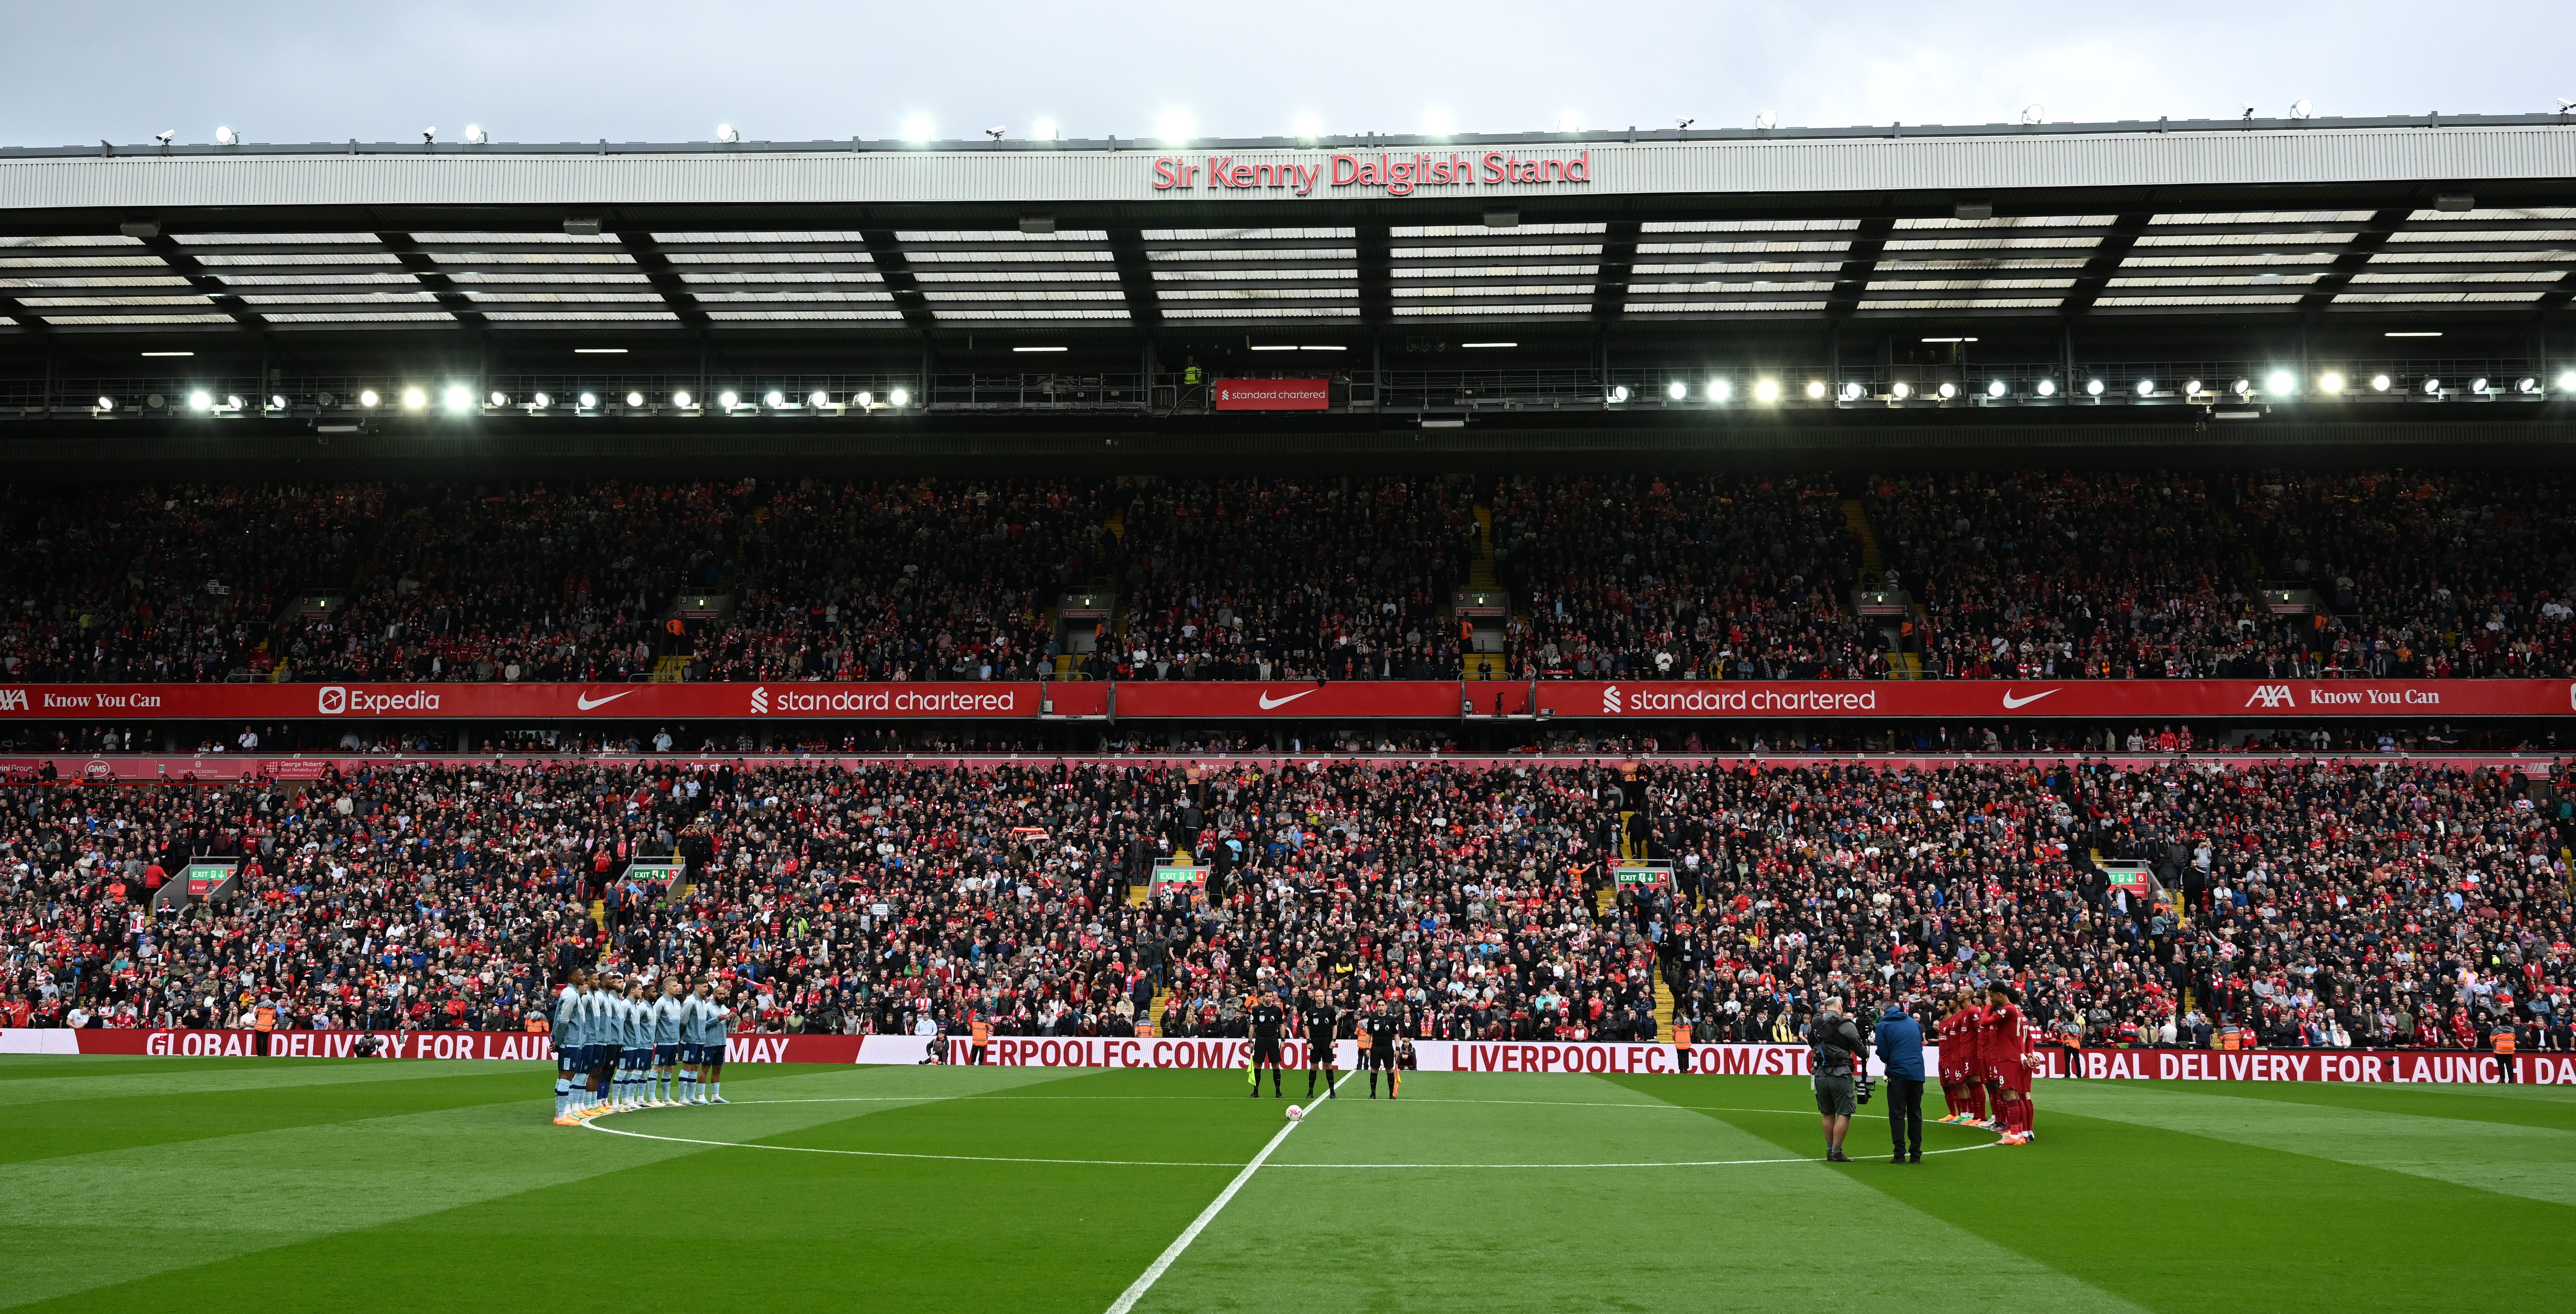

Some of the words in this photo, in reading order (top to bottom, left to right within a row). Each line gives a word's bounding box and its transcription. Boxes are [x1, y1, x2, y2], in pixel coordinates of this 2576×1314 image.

[1155, 158, 1197, 187] Sir
[1210, 158, 1319, 193] Kenny
[1333, 154, 1473, 193] Dalglish
[1484, 151, 1588, 182] Stand
[44, 694, 91, 707] Know
[96, 694, 125, 706] You
[131, 694, 160, 706] Can
[351, 690, 439, 714] Expedia
[778, 691, 888, 710] standard
[896, 691, 1013, 710] chartered
[1631, 690, 1745, 710] standard
[1752, 690, 1875, 709] chartered
[2245, 686, 2295, 707] AXA
[2310, 690, 2362, 703] Know
[2367, 690, 2401, 703] You
[2406, 690, 2440, 703] Can
[147, 1033, 257, 1056] GLOBAL
[418, 1035, 473, 1059] FOR
[725, 1038, 789, 1063] MAY
[1955, 1070, 1962, 1078] 66
[1965, 1062, 1969, 1070] 3
[2160, 1054, 2309, 1081] DELIVERY
[2321, 1056, 2382, 1082] FOR
[1999, 1075, 2004, 1085] 8
